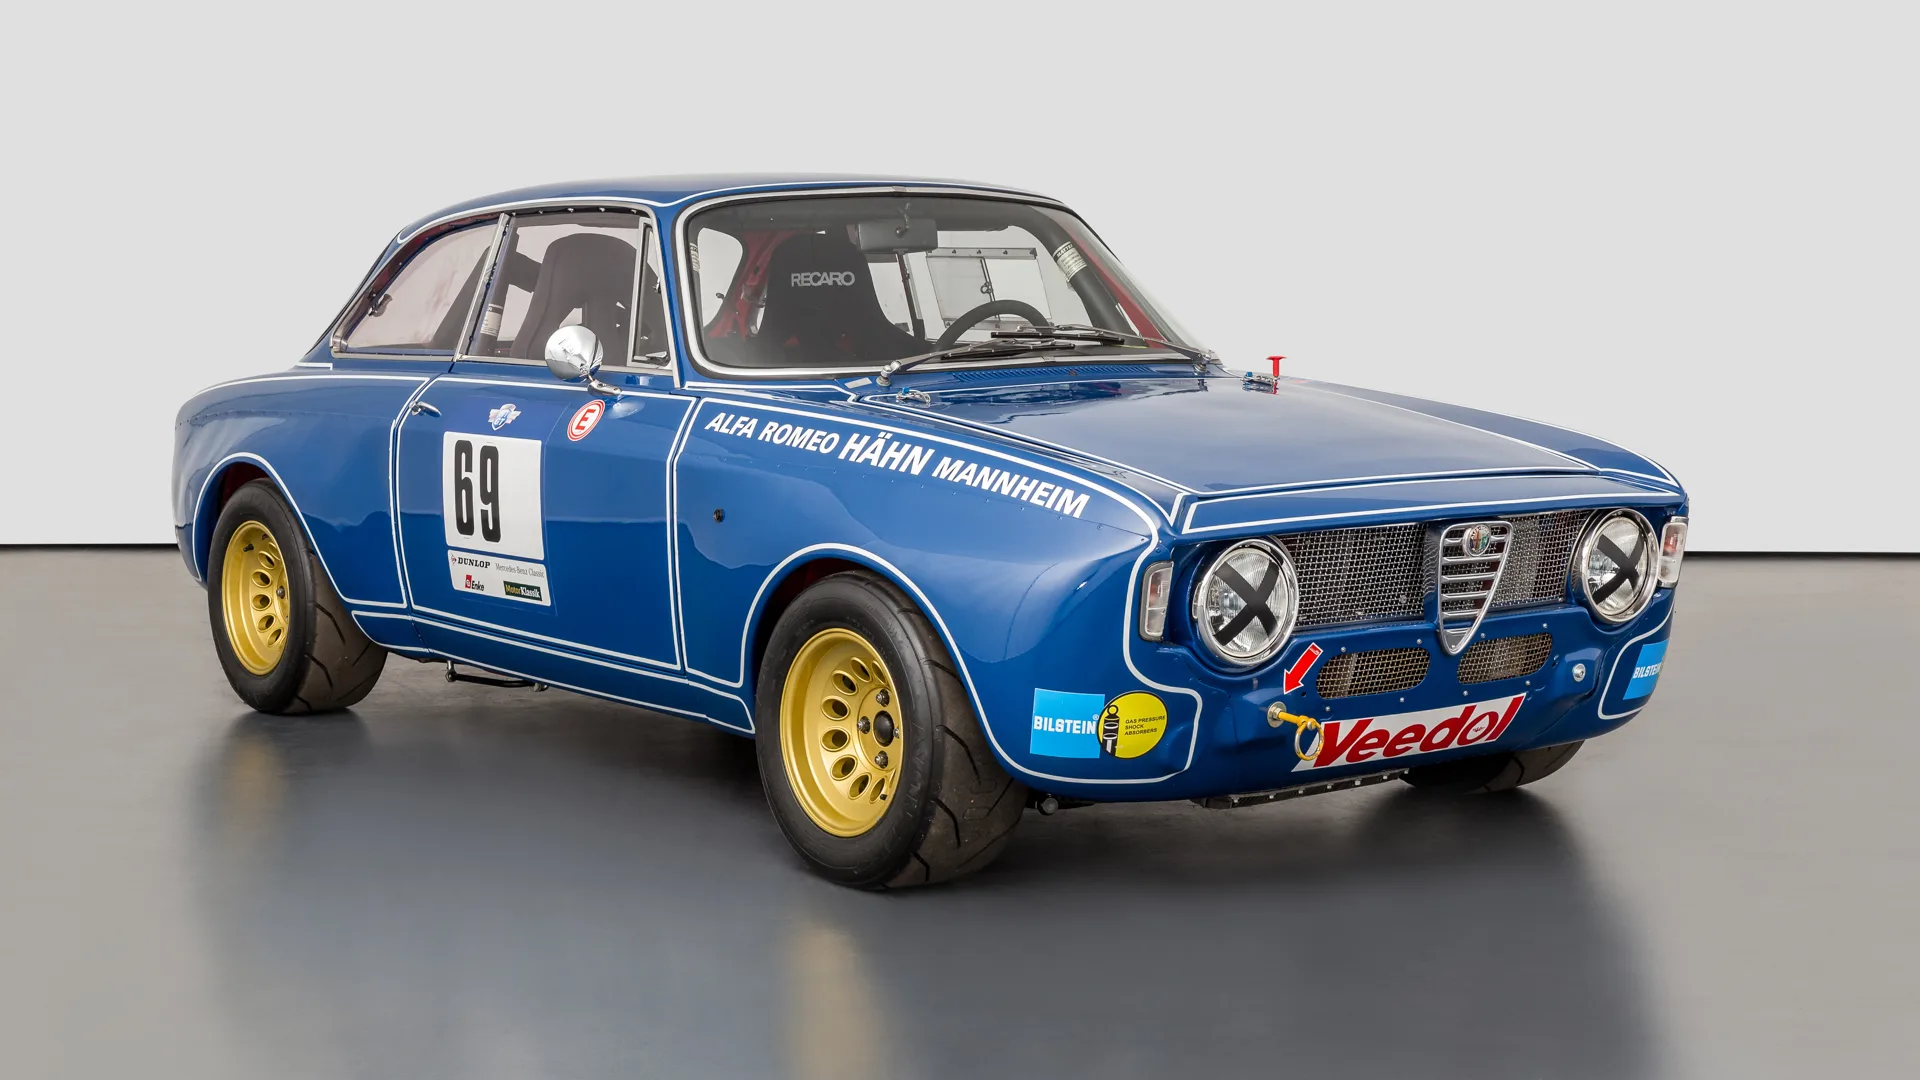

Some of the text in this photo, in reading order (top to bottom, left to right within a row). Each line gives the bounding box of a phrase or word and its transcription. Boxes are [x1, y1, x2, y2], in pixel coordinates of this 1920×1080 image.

[791, 271, 856, 287] RECARO
[575, 408, 596, 430] E
[704, 412, 1091, 518] ALFA ROMEO HÄHN MANNHEIM
[454, 439, 501, 543] 69
[457, 556, 491, 569] DUNLOP
[495, 562, 545, 579] Mercedes-Benz Classic
[471, 580, 485, 592] Enke
[1033, 715, 1097, 735] BILSTEIN
[1138, 715, 1166, 723] PRESSURE
[1124, 728, 1158, 736] ABSORBERS
[1312, 695, 1525, 768] Veedol
